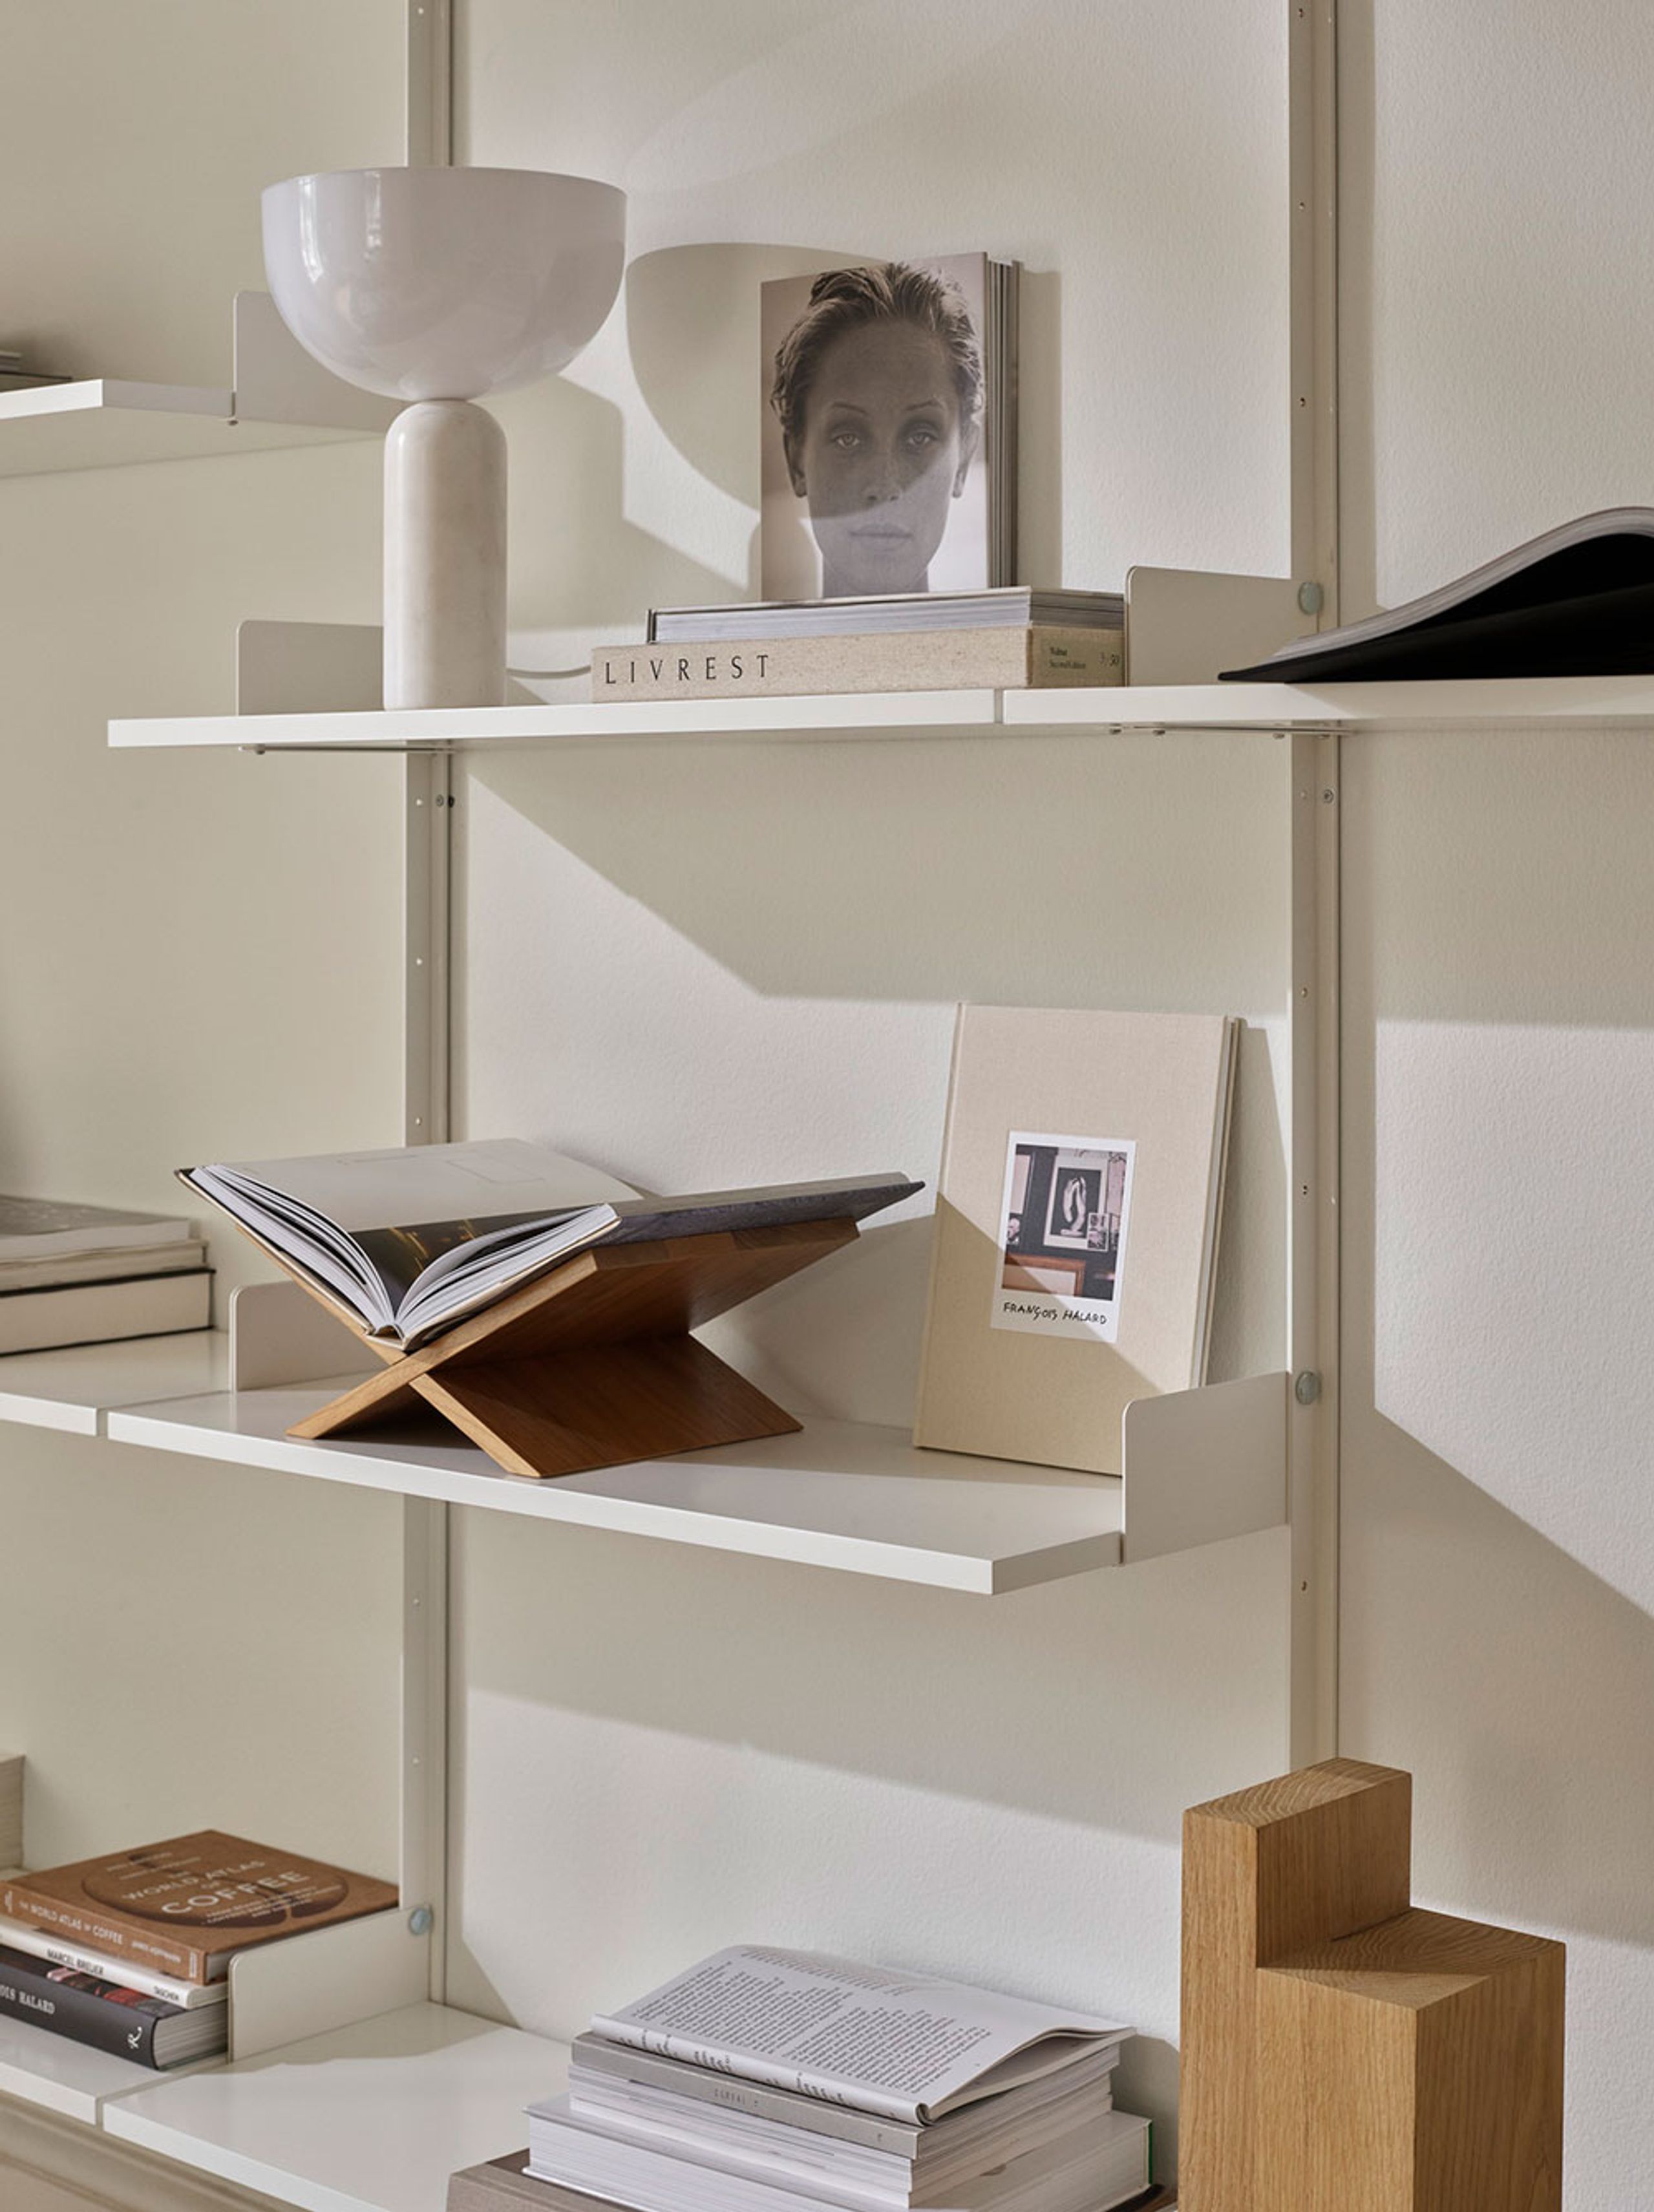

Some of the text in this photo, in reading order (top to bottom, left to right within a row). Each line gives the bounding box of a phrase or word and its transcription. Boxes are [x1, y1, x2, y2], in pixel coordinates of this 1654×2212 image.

[605, 654, 769, 685] LIVREST
[1003, 1302, 1107, 1324] FRANÇOIS HALARD
[161, 1871, 312, 1915] COFFEE
[59, 1913, 82, 1931] ATLAS
[92, 1924, 123, 1945] COFFEE
[18, 1991, 56, 2015] HALARD
